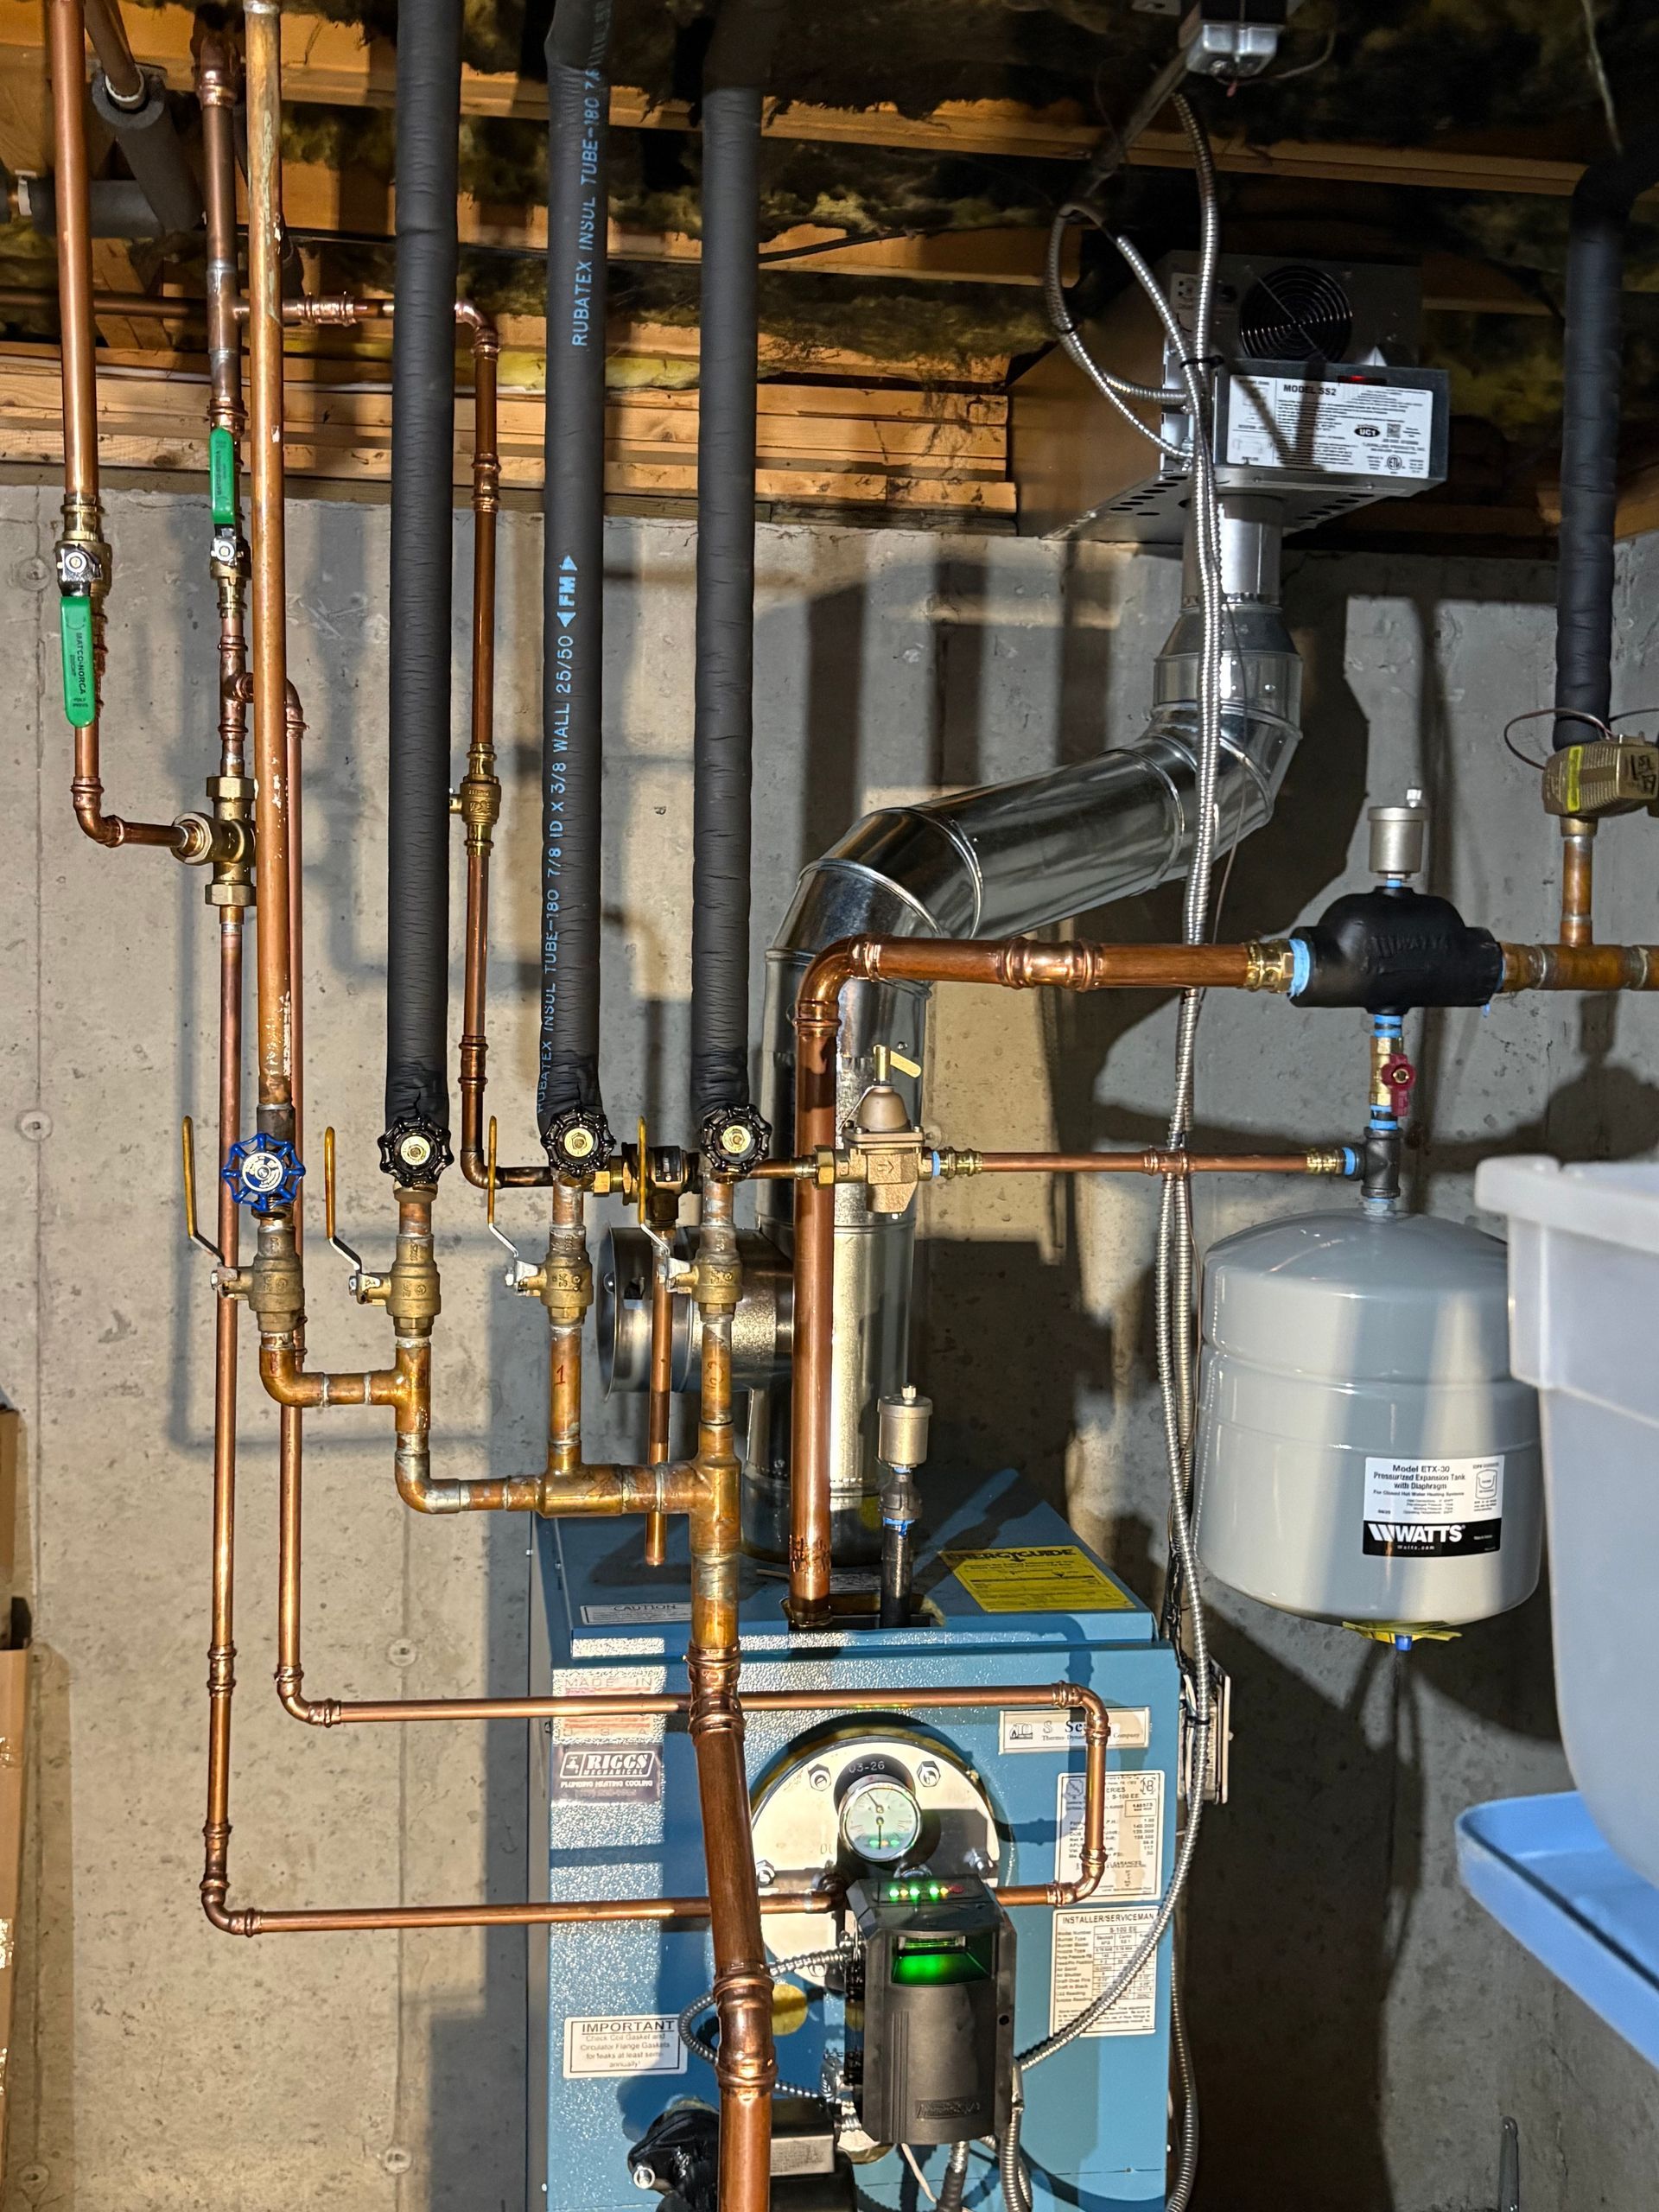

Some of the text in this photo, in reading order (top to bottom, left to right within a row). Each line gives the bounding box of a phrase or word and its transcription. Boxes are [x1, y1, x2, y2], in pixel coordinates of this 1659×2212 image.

[580, 97, 600, 186] TUBE-180
[579, 197, 596, 251] INSUL
[572, 261, 592, 346] RUBATEX
[1283, 384, 1337, 397] MODEL SS2
[557, 576, 576, 607] FM
[556, 634, 575, 694] 25/50
[551, 702, 570, 753] WALL
[550, 762, 567, 794] 3/8
[550, 801, 565, 812] X
[550, 820, 564, 838] ID
[547, 847, 562, 878] 7/8
[544, 888, 560, 975] TUBE-180
[543, 982, 556, 1032] INSUL
[553, 1364, 566, 1386] 1
[1373, 1471, 1414, 1481] Pressurized
[1415, 1473, 1449, 1483] Expansion
[1392, 1464, 1419, 1473] Model
[1411, 1482, 1447, 1491] Diaphragm
[1395, 1524, 1463, 1543] WATTS
[564, 1677, 652, 1688] MADE IN
[587, 1754, 648, 1770] RIGGS
[582, 2020, 675, 2033] IMPORTANT
